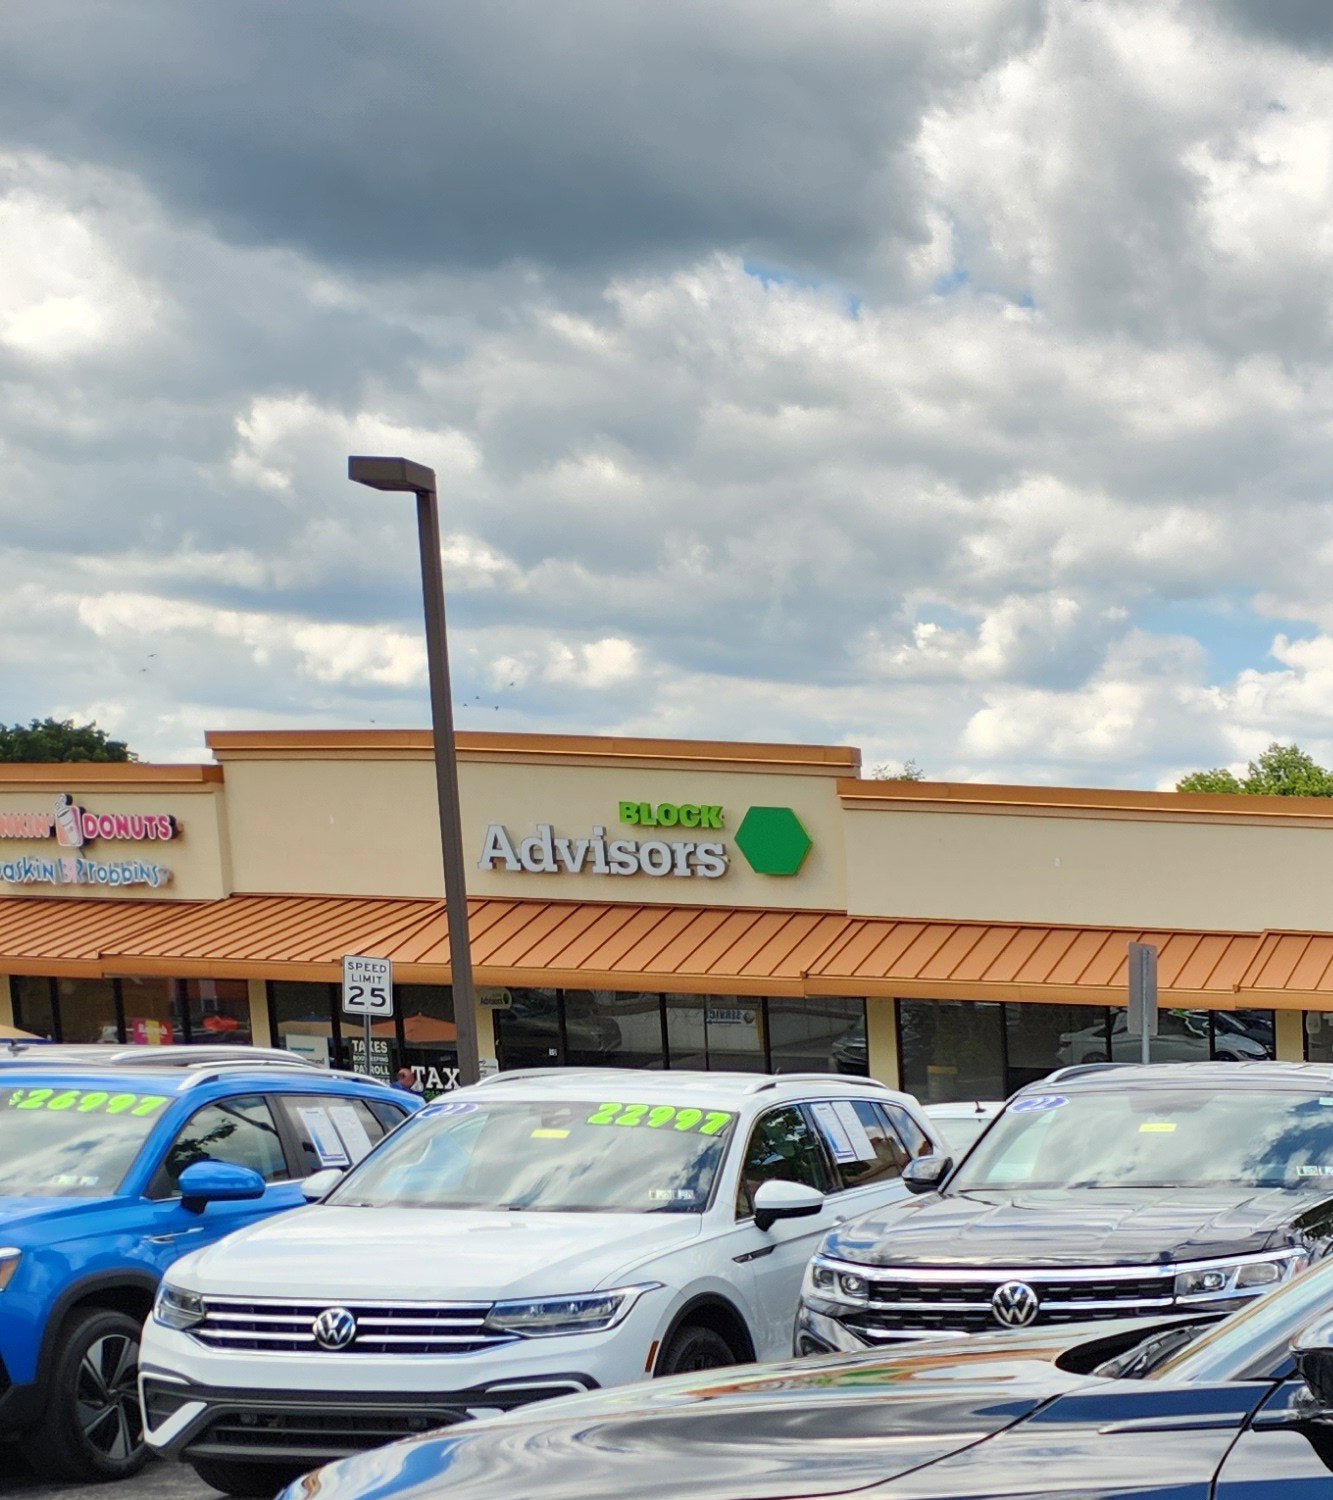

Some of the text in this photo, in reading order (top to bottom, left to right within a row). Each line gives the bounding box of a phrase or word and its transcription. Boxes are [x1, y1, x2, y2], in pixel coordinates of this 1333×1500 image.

[82, 812, 174, 840] DONUTS
[618, 801, 725, 829] BLOCK
[478, 823, 729, 879] Advisors
[0, 857, 55, 884] askin
[87, 859, 163, 888] robbins
[347, 961, 387, 974] SPEED
[351, 973, 382, 984] LIMIT
[347, 985, 386, 1008] 25
[410, 1065, 461, 1093] TAX
[586, 1101, 732, 1135] 22997
